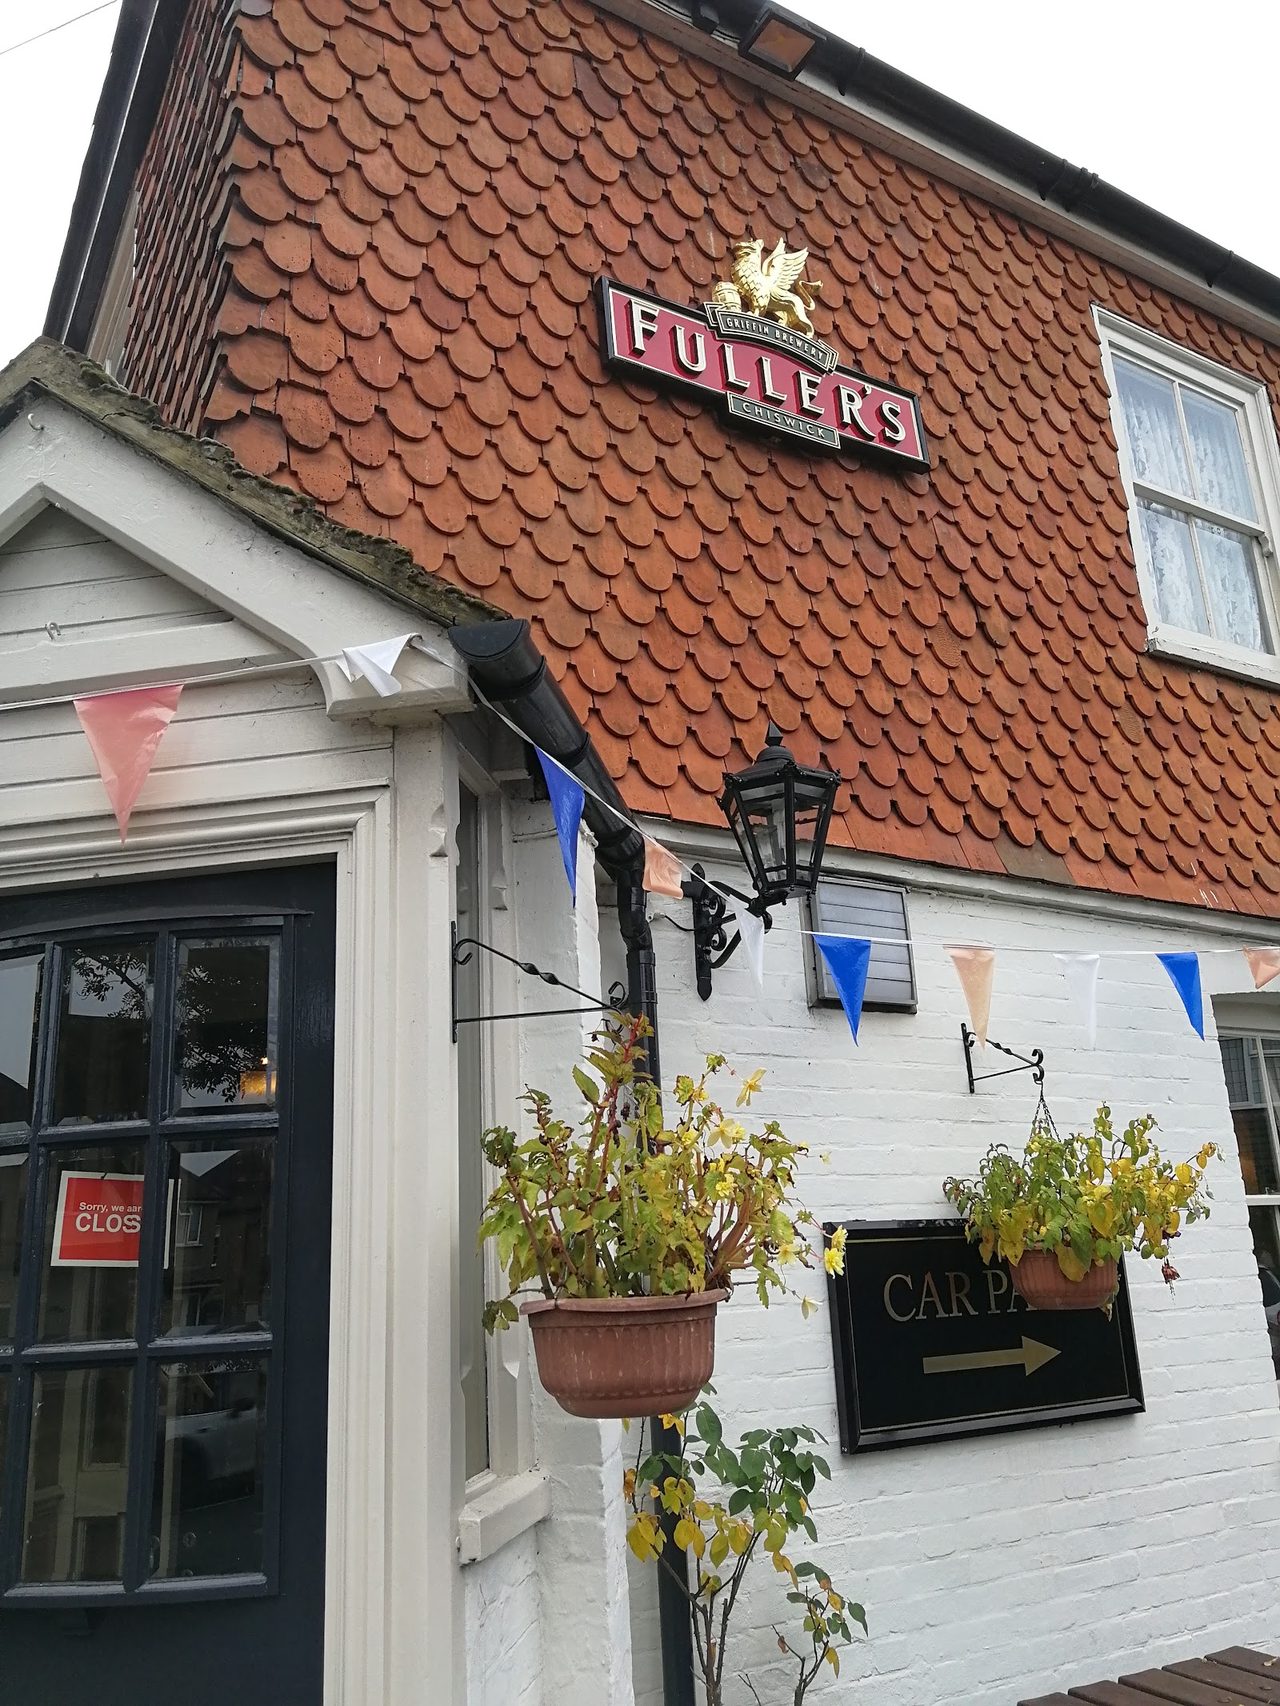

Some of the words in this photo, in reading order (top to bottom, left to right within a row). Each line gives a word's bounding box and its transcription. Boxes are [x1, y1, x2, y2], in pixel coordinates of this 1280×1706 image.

[726, 317, 769, 335] GRIFFIN
[775, 331, 824, 360] BREWERY
[629, 299, 906, 442] FULLER'S
[742, 402, 825, 438] CHISWICK
[79, 1201, 109, 1213] Sorry,
[111, 1204, 125, 1212] we
[883, 1271, 979, 1322] CAR
